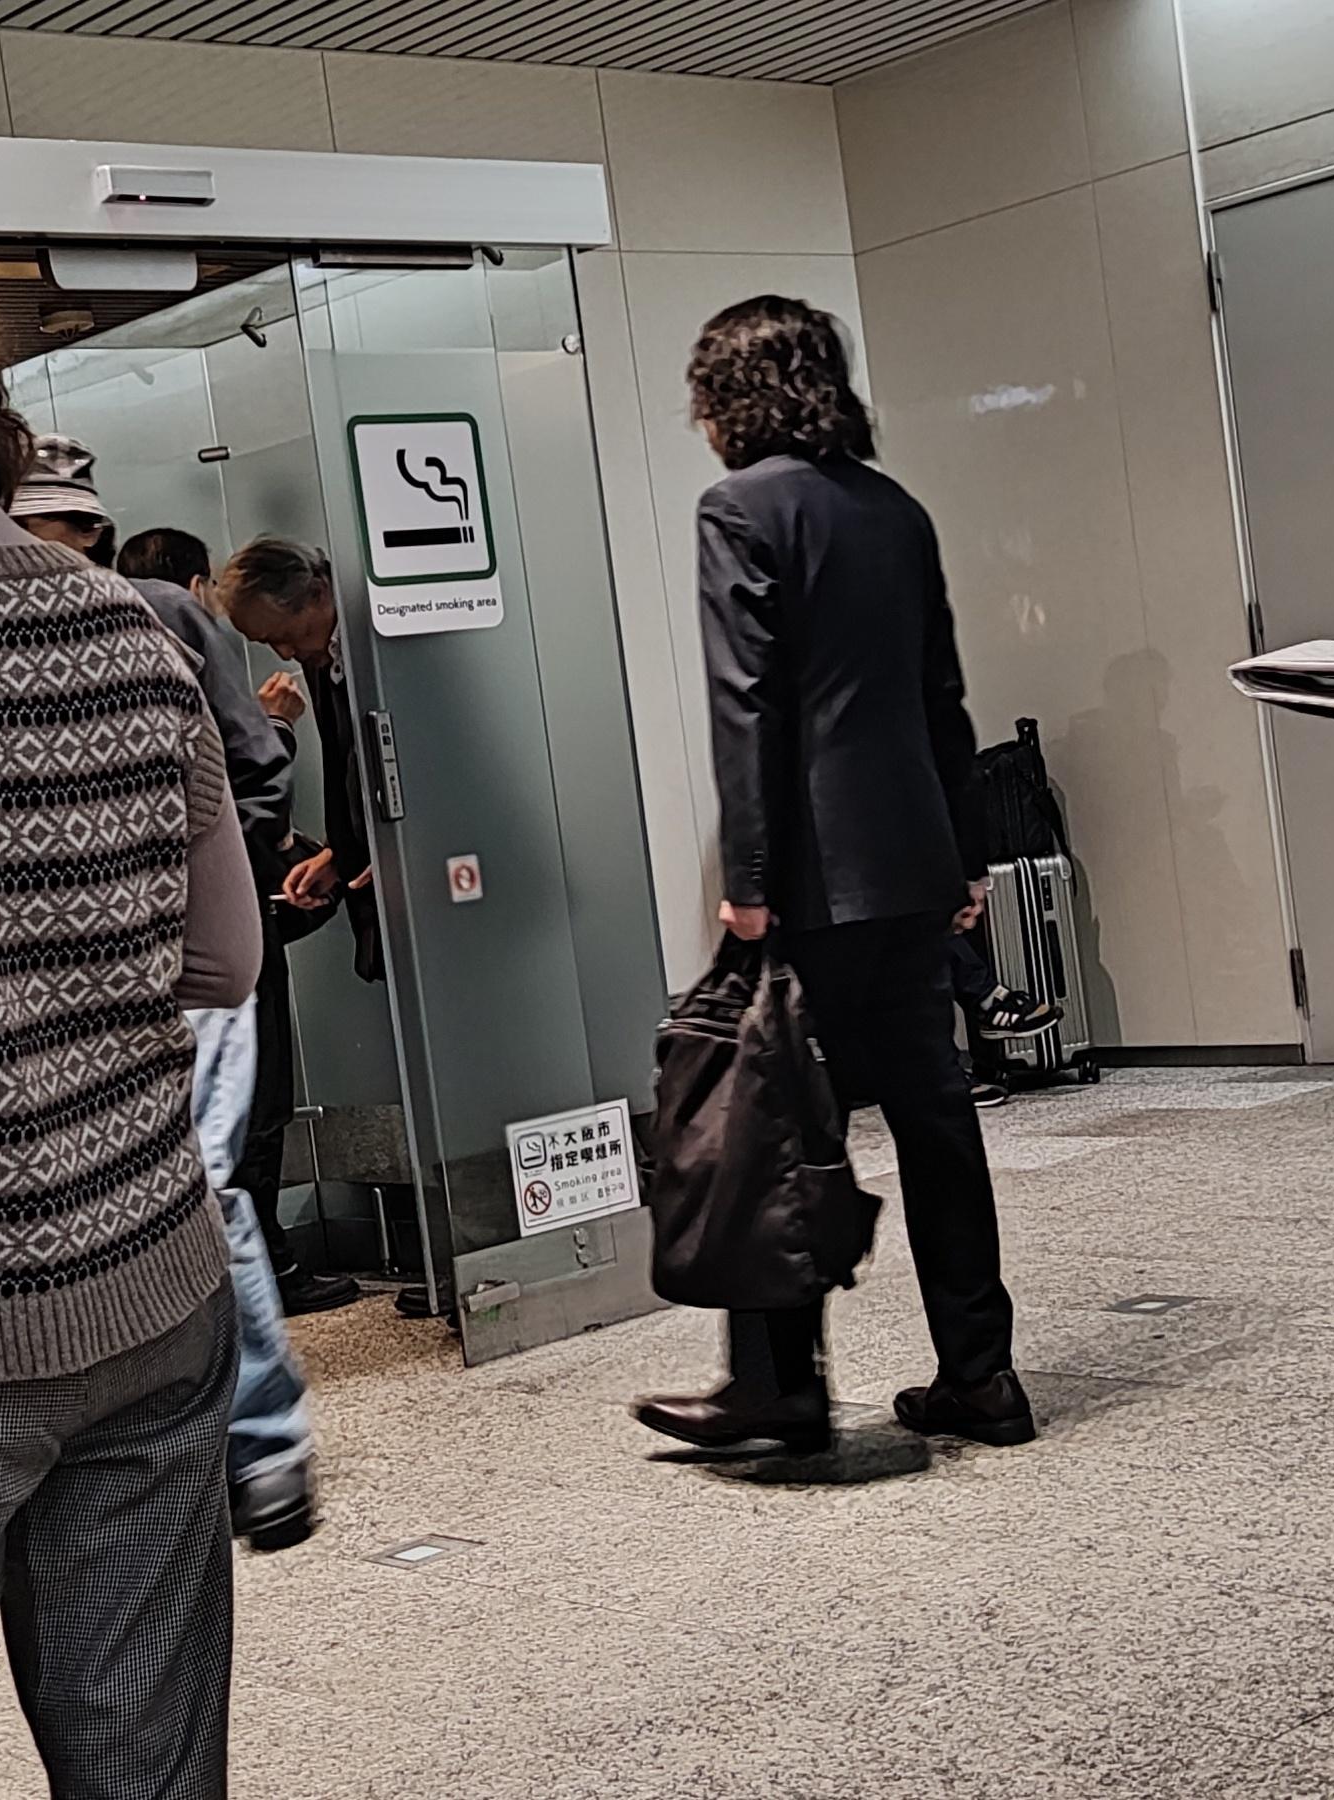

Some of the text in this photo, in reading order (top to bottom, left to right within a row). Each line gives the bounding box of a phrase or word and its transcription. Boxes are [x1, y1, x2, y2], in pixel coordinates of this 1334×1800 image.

[377, 596, 497, 617] Designated smoking area
[549, 1138, 623, 1173] 指定喫煙所
[554, 1172, 598, 1192] Smoking
[600, 1167, 622, 1181] area
